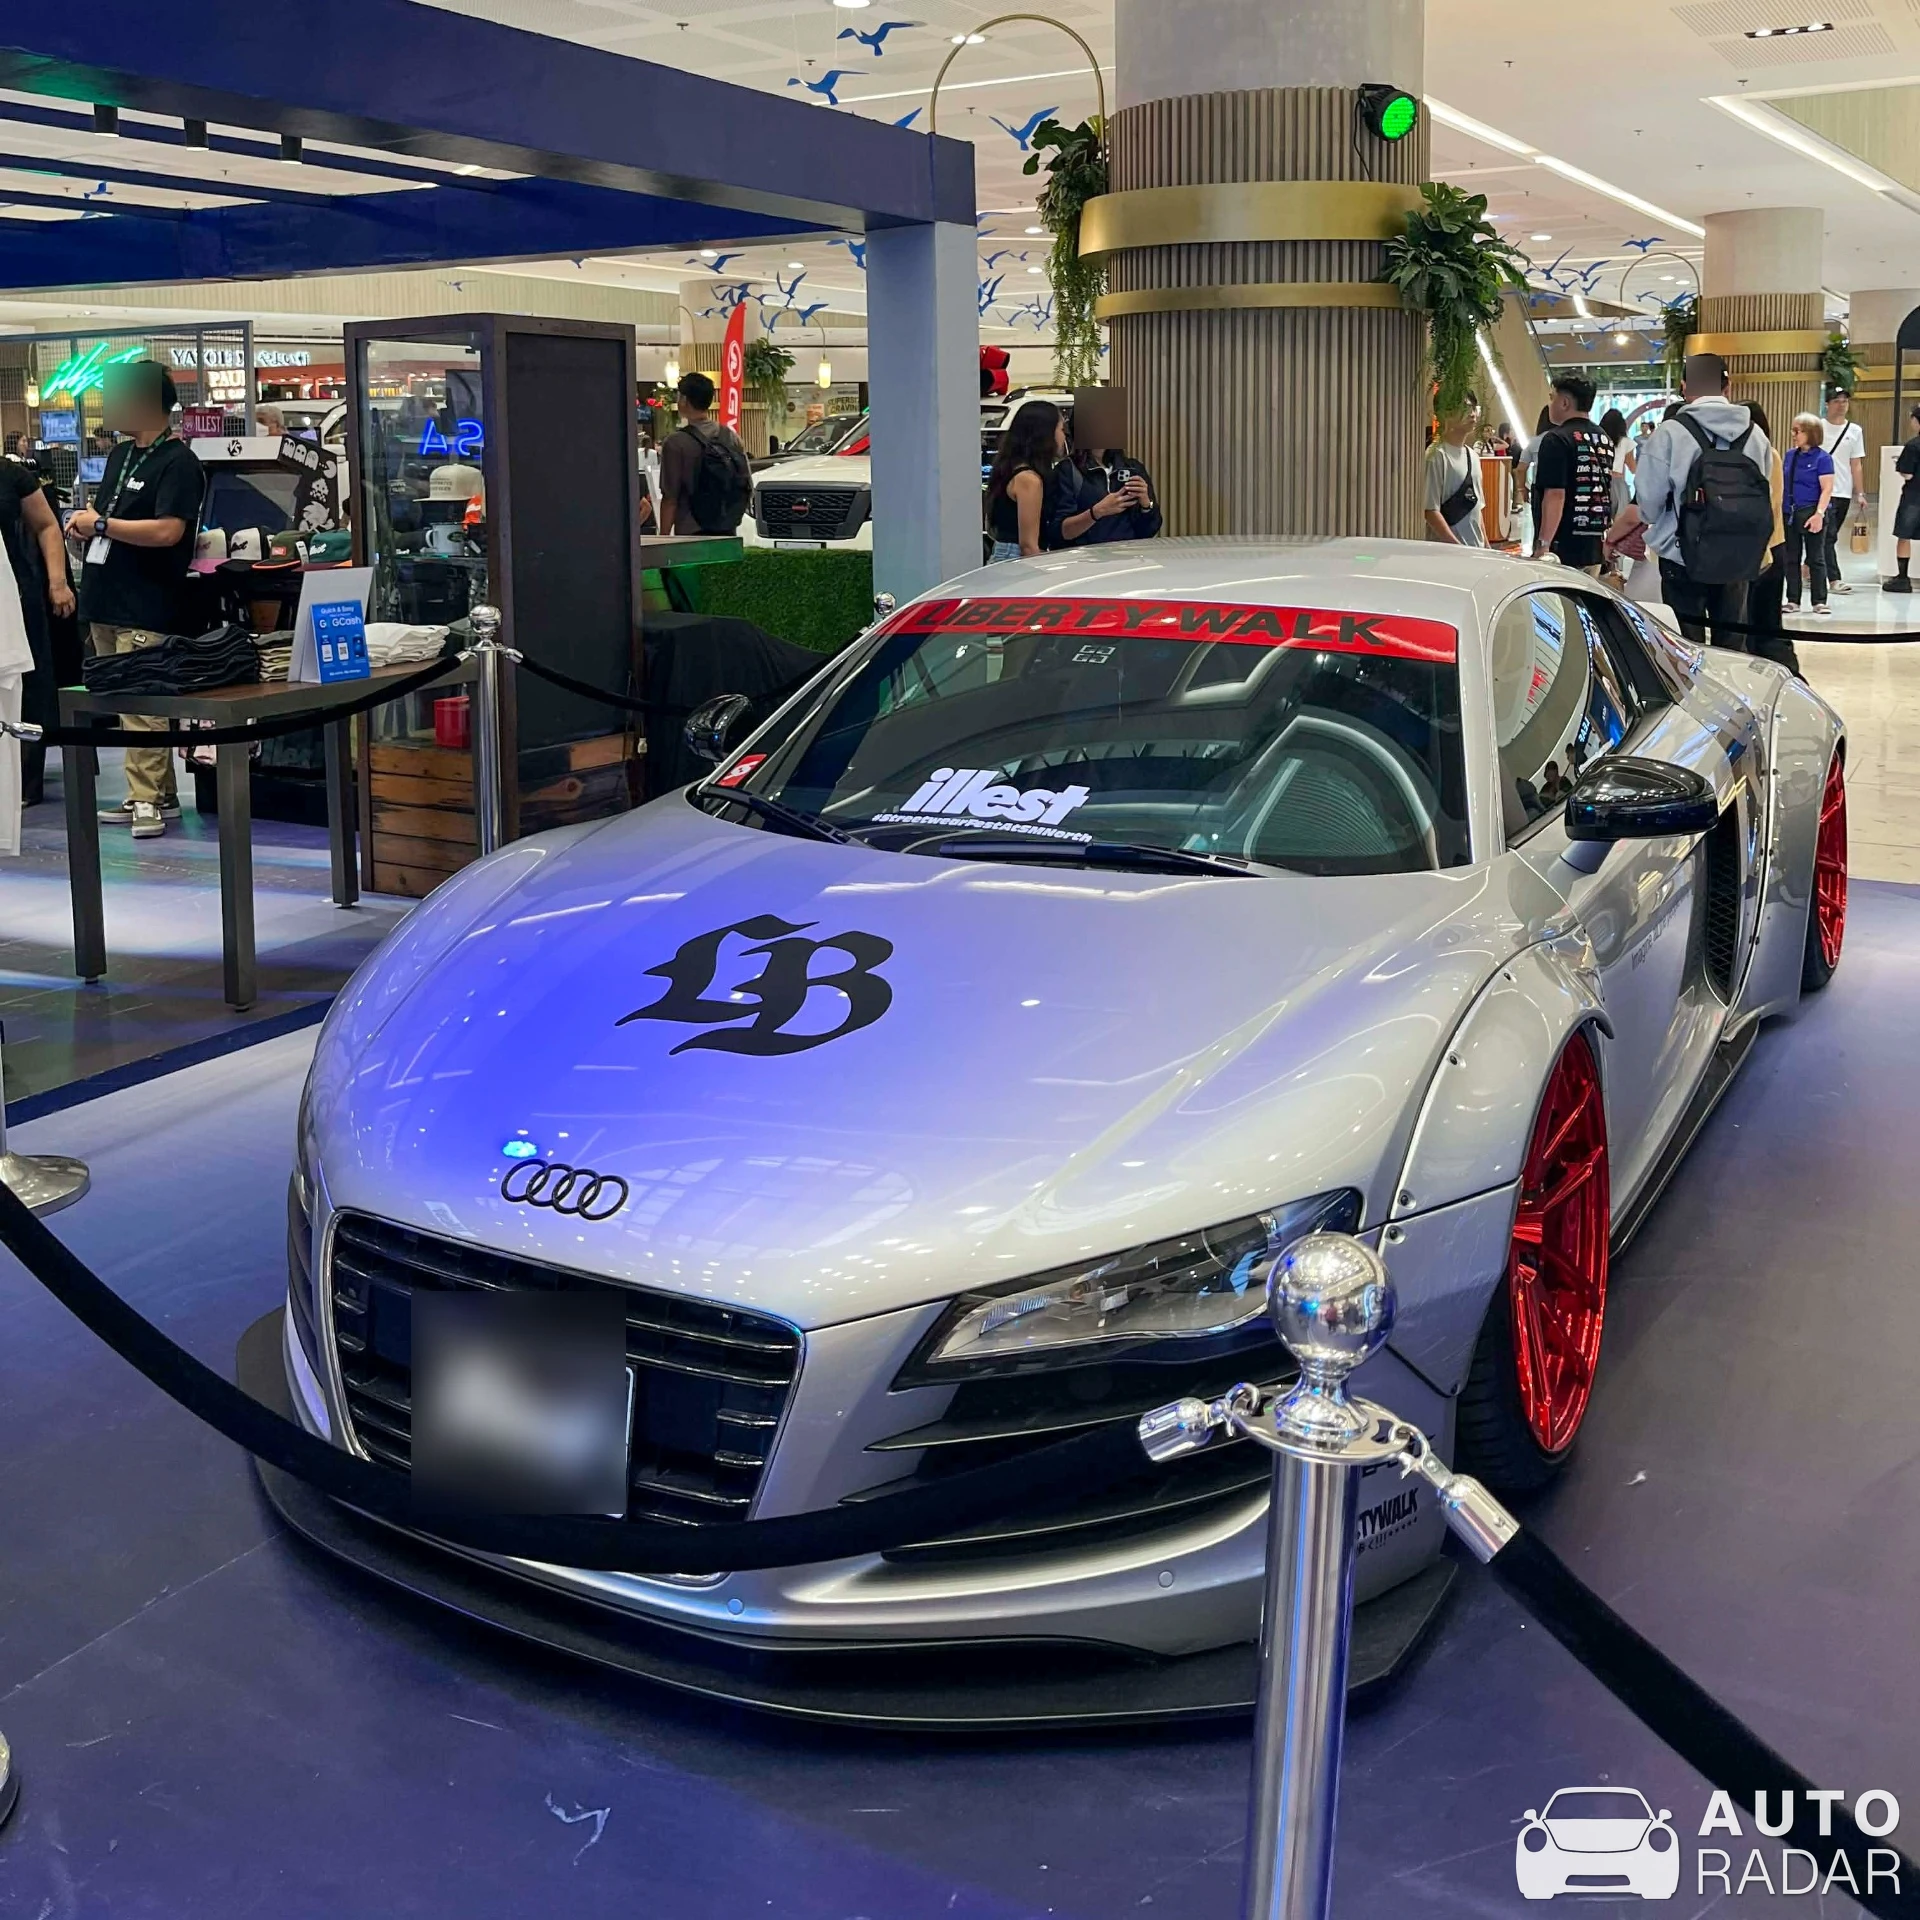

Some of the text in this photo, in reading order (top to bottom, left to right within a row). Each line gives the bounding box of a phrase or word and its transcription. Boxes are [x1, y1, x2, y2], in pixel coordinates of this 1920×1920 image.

[195, 415, 221, 433] ILLEST
[332, 616, 361, 627] GCash
[915, 602, 1385, 646] LIBERTY WALK
[900, 767, 1091, 826] illest
[871, 812, 1094, 844] #StreetwearFestAtSMNorth
[614, 913, 894, 1056] LB
[1358, 1487, 1419, 1538] TYWALK
